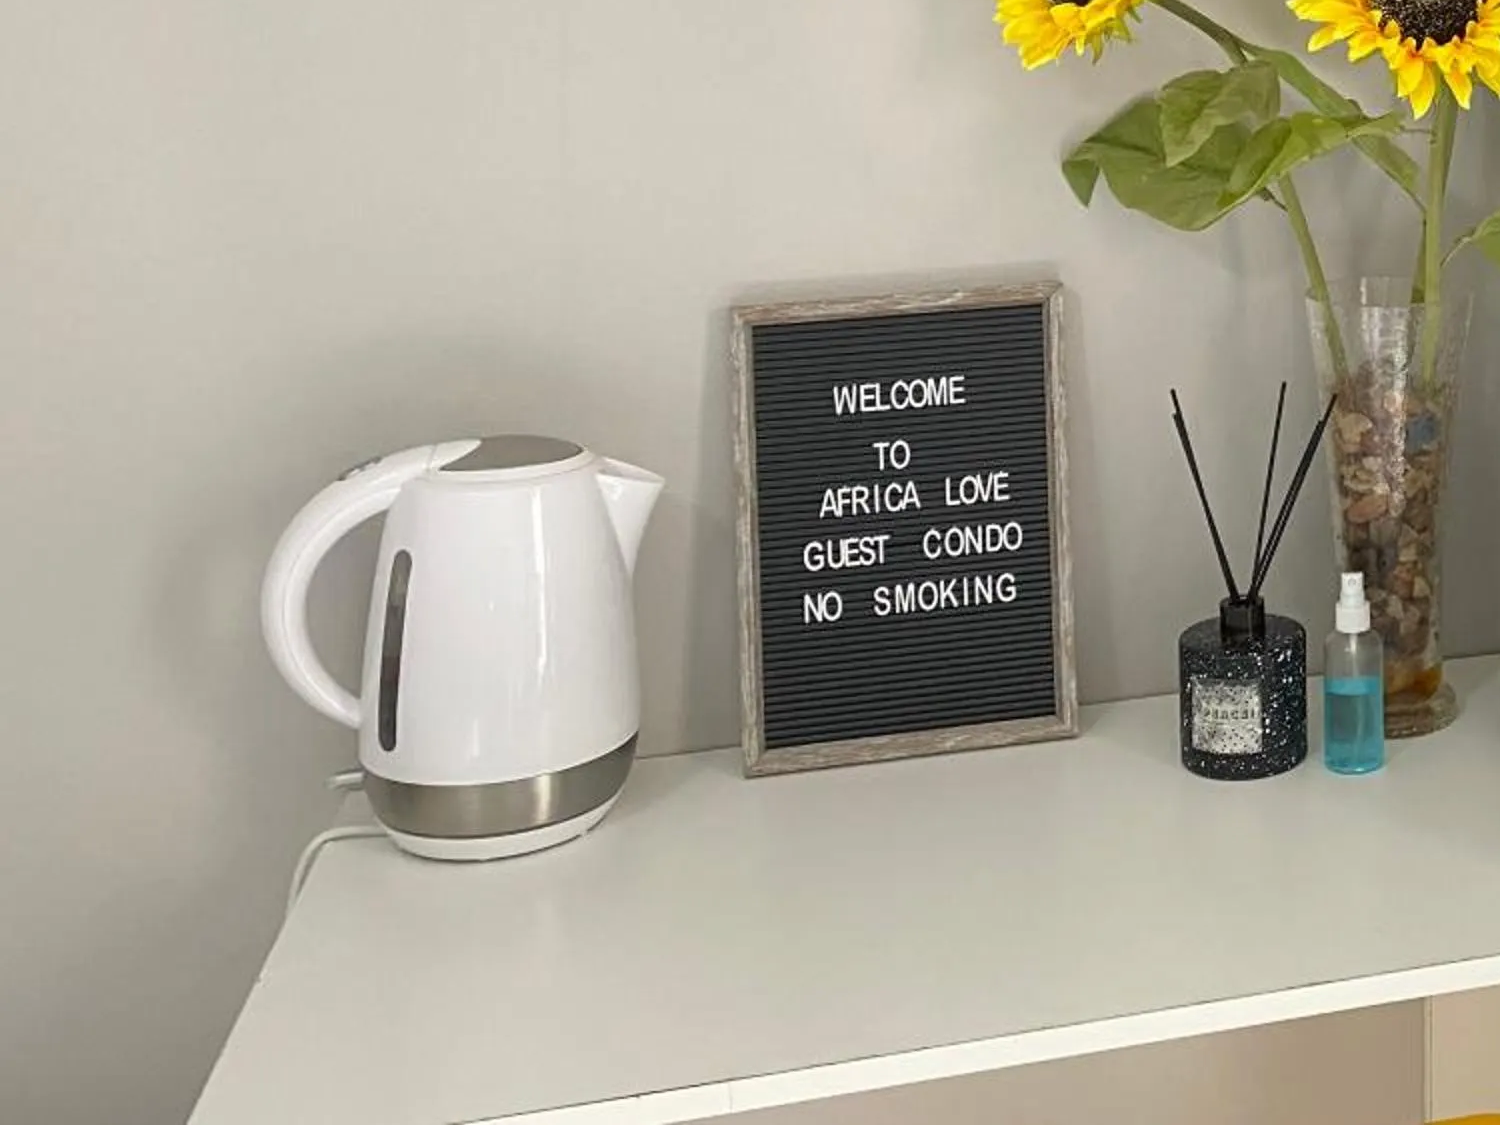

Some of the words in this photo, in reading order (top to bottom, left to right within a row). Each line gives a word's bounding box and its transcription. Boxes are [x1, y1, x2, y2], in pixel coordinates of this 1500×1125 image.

[833, 375, 967, 416] WELCOME
[872, 439, 911, 471] TO
[819, 480, 922, 519] AFRICA
[945, 470, 1011, 506] LOVE
[803, 534, 891, 572] GUEST
[922, 521, 1023, 560] CONDO
[803, 590, 843, 624] NO
[873, 572, 1017, 616] SMOKING
